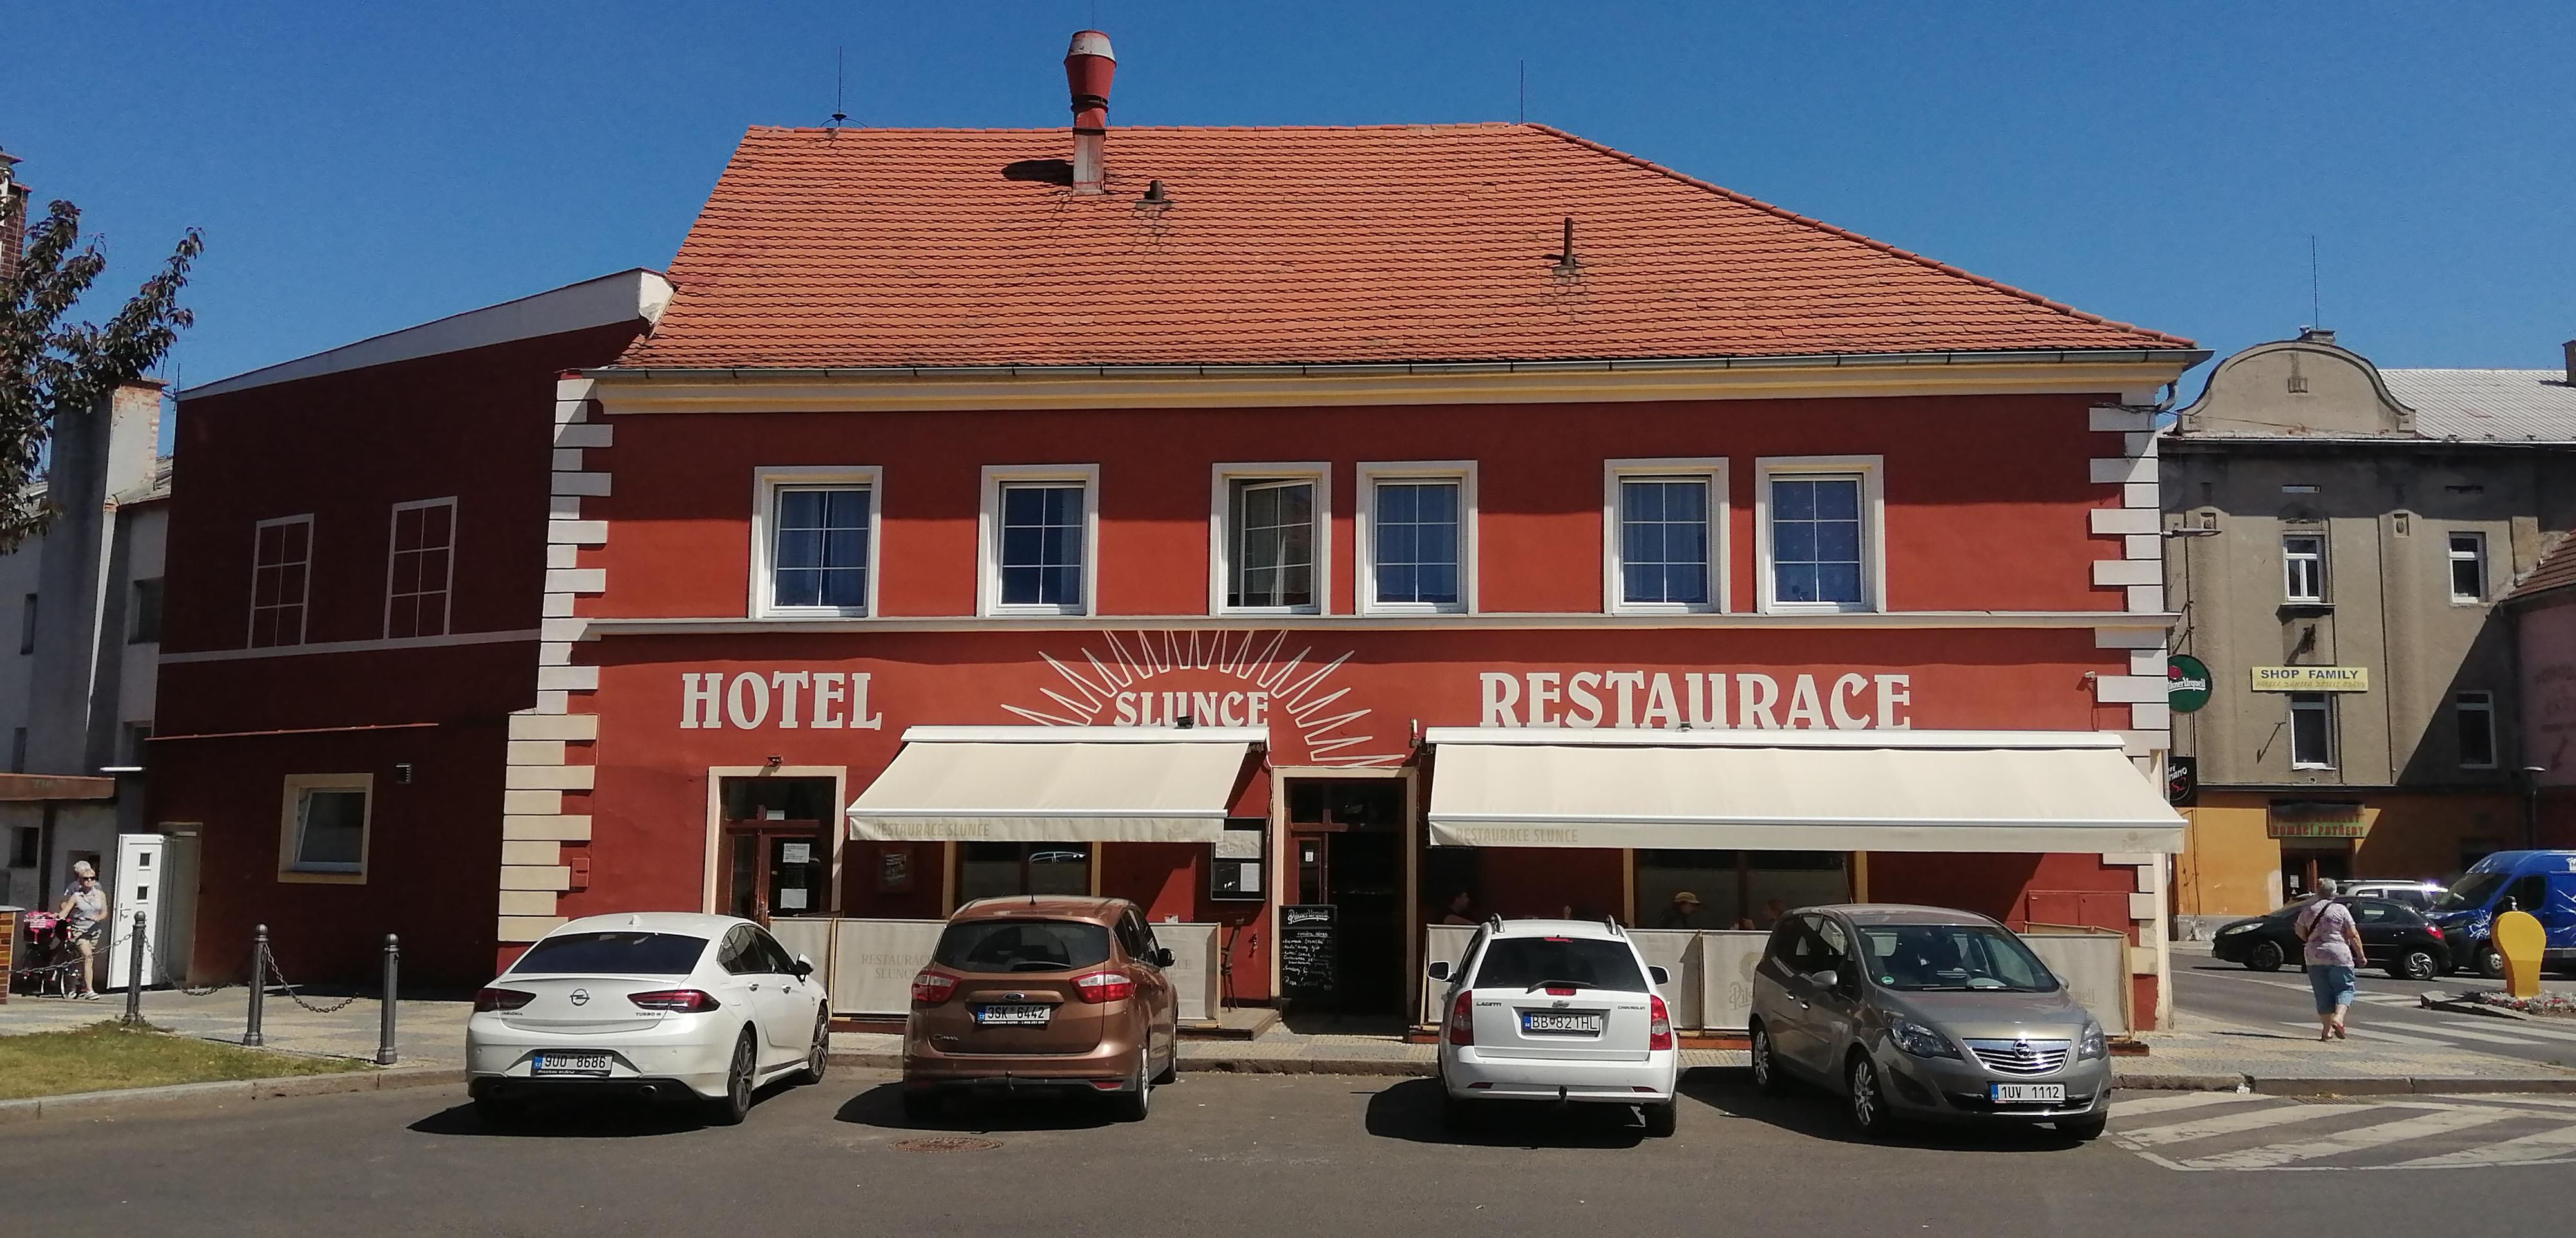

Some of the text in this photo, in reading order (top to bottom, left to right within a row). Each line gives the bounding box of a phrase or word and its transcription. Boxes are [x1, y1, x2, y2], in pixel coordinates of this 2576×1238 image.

[2261, 670, 2358, 679] SHOP FAMILY
[2168, 677, 2206, 691] ilsner Urquell
[680, 671, 882, 730] HOTEL
[1480, 670, 1911, 730] RESTAURACE
[1113, 691, 1268, 727] SLUNCE
[873, 823, 990, 837] RESTAURACE SLUNCE
[1455, 827, 1578, 843] RESTAURACE SLUNCE
[988, 1007, 1008, 1019] 3SK
[1017, 1007, 1045, 1019] 6442
[576, 1056, 606, 1068] 8686
[2002, 1086, 2021, 1098] 1UV
[2032, 1086, 2060, 1098] 1112
